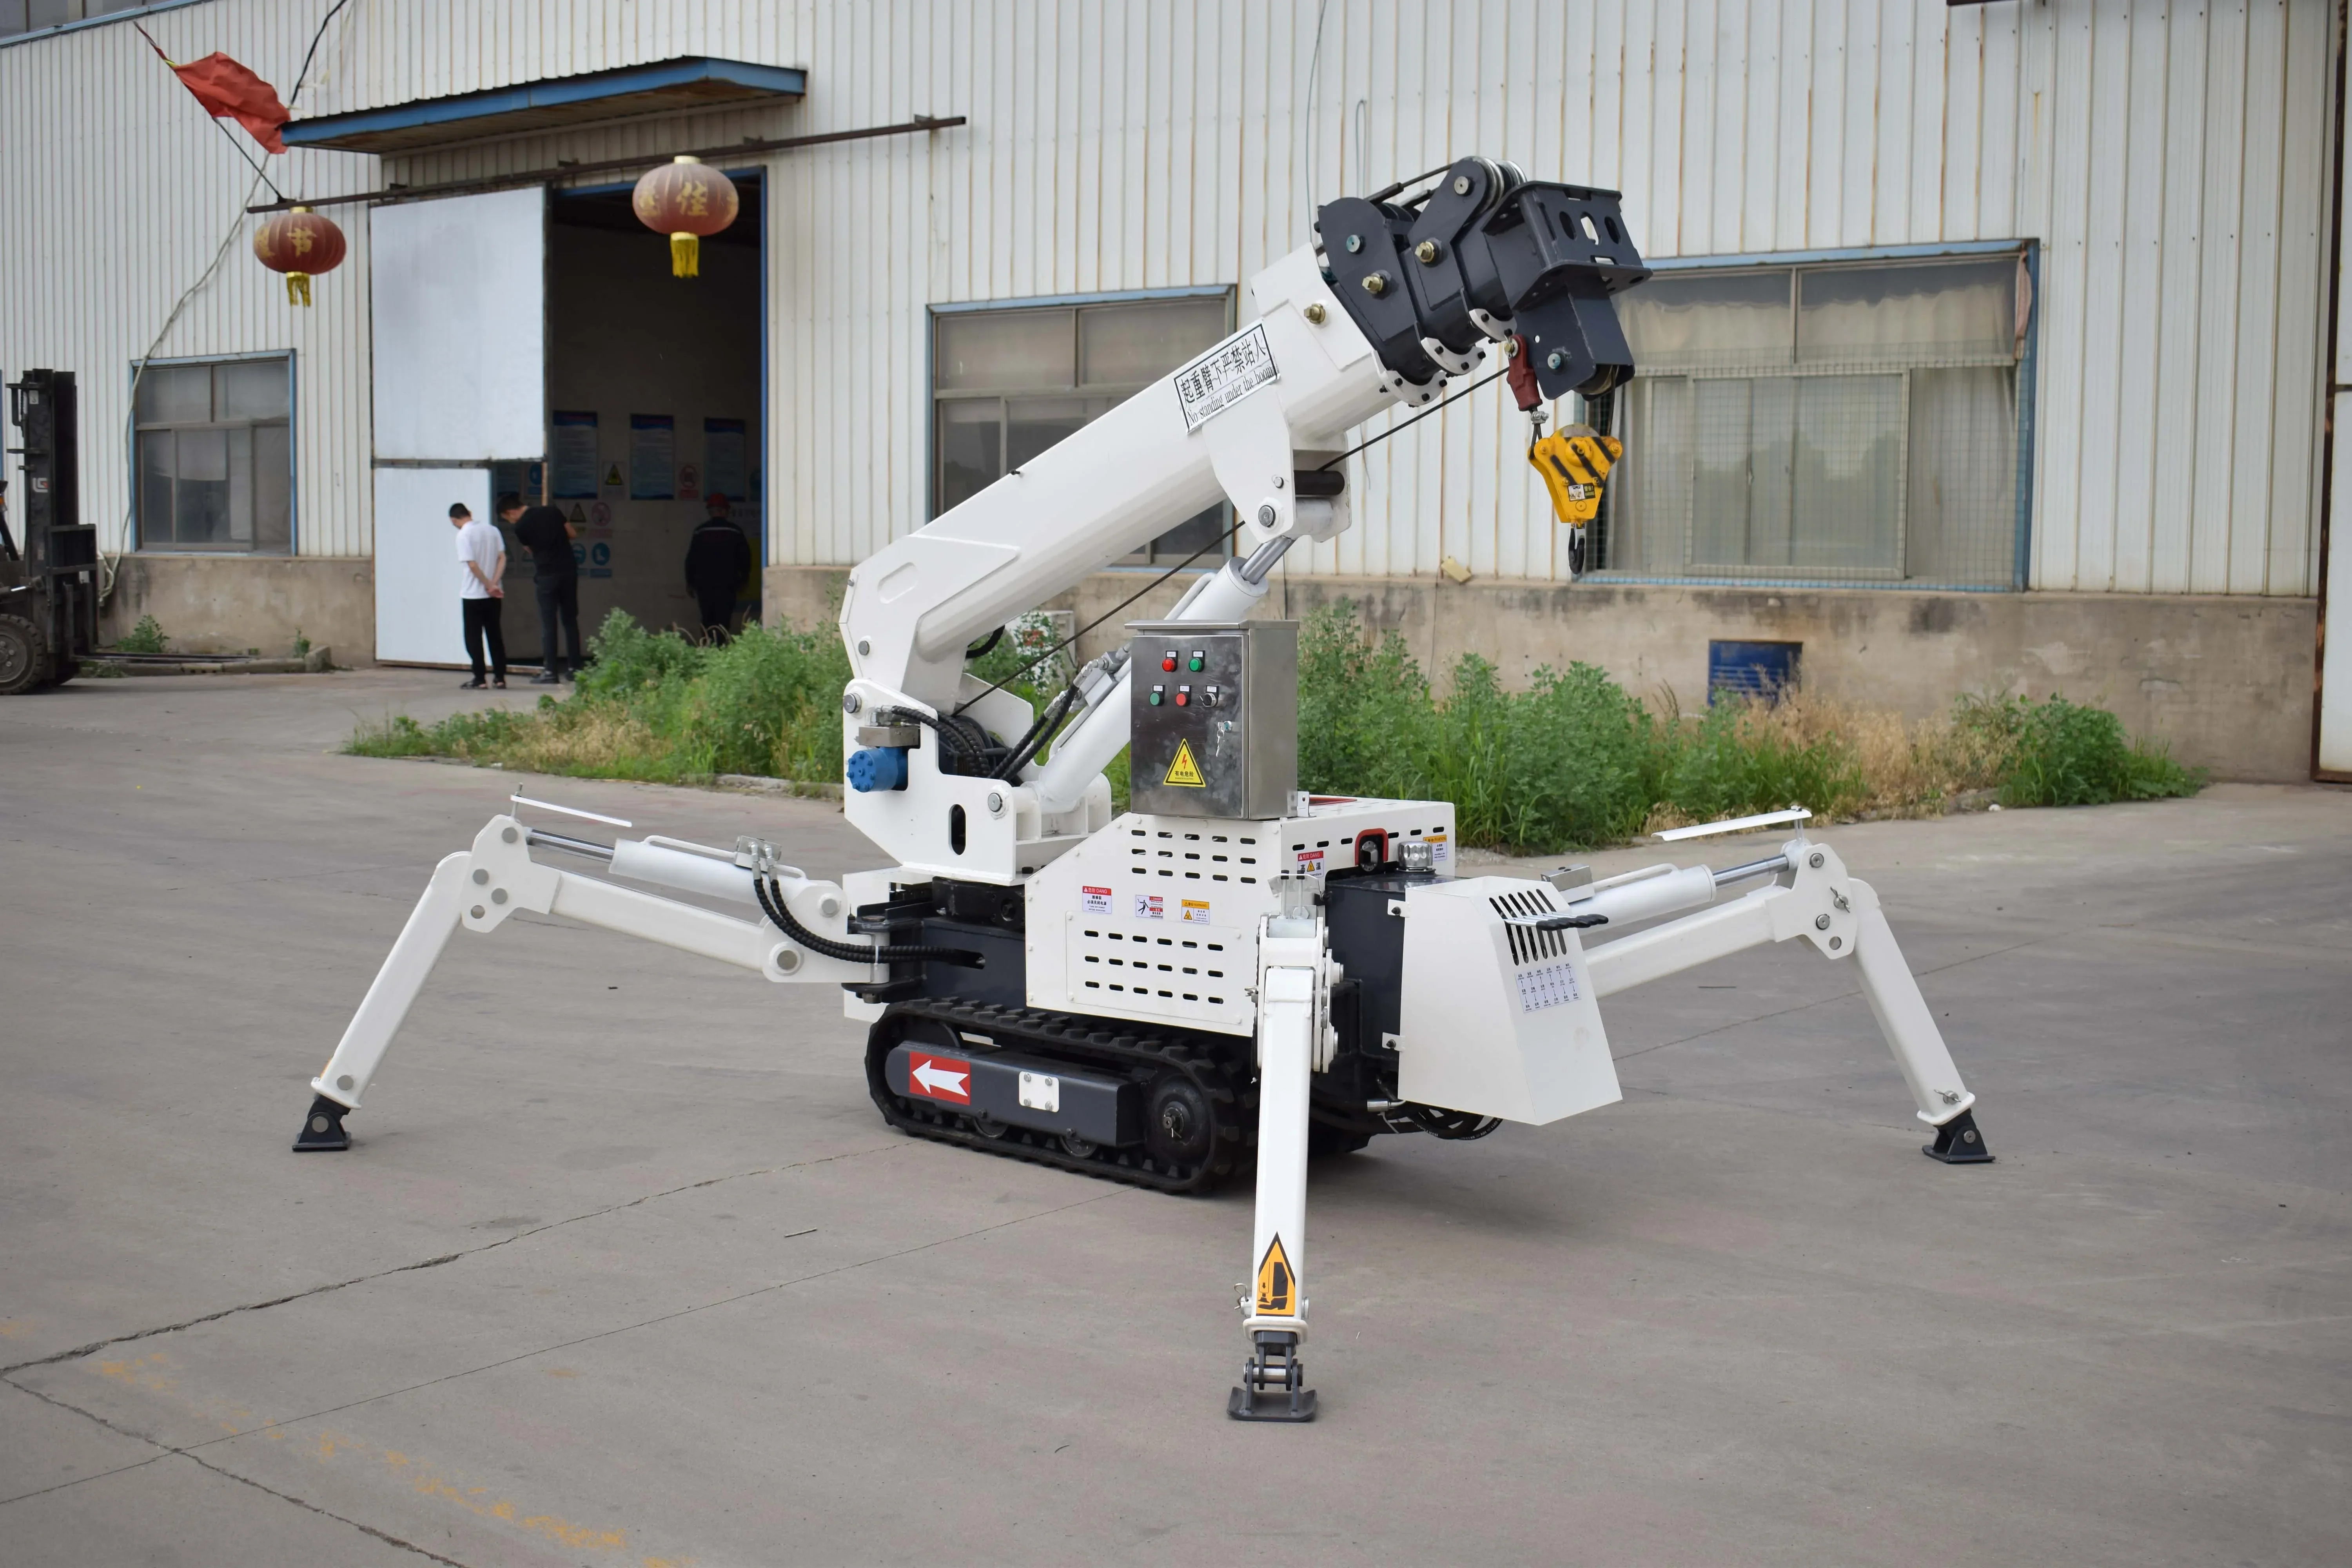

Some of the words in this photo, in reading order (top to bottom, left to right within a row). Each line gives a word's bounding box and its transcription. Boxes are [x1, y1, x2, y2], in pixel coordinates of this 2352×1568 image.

[1181, 333, 1266, 407] 起重臂下严禁站人
[1187, 410, 1198, 426] No
[1200, 394, 1225, 419] standing
[1225, 384, 1243, 404] under
[1243, 376, 1254, 392] the
[1254, 365, 1274, 386] boom
